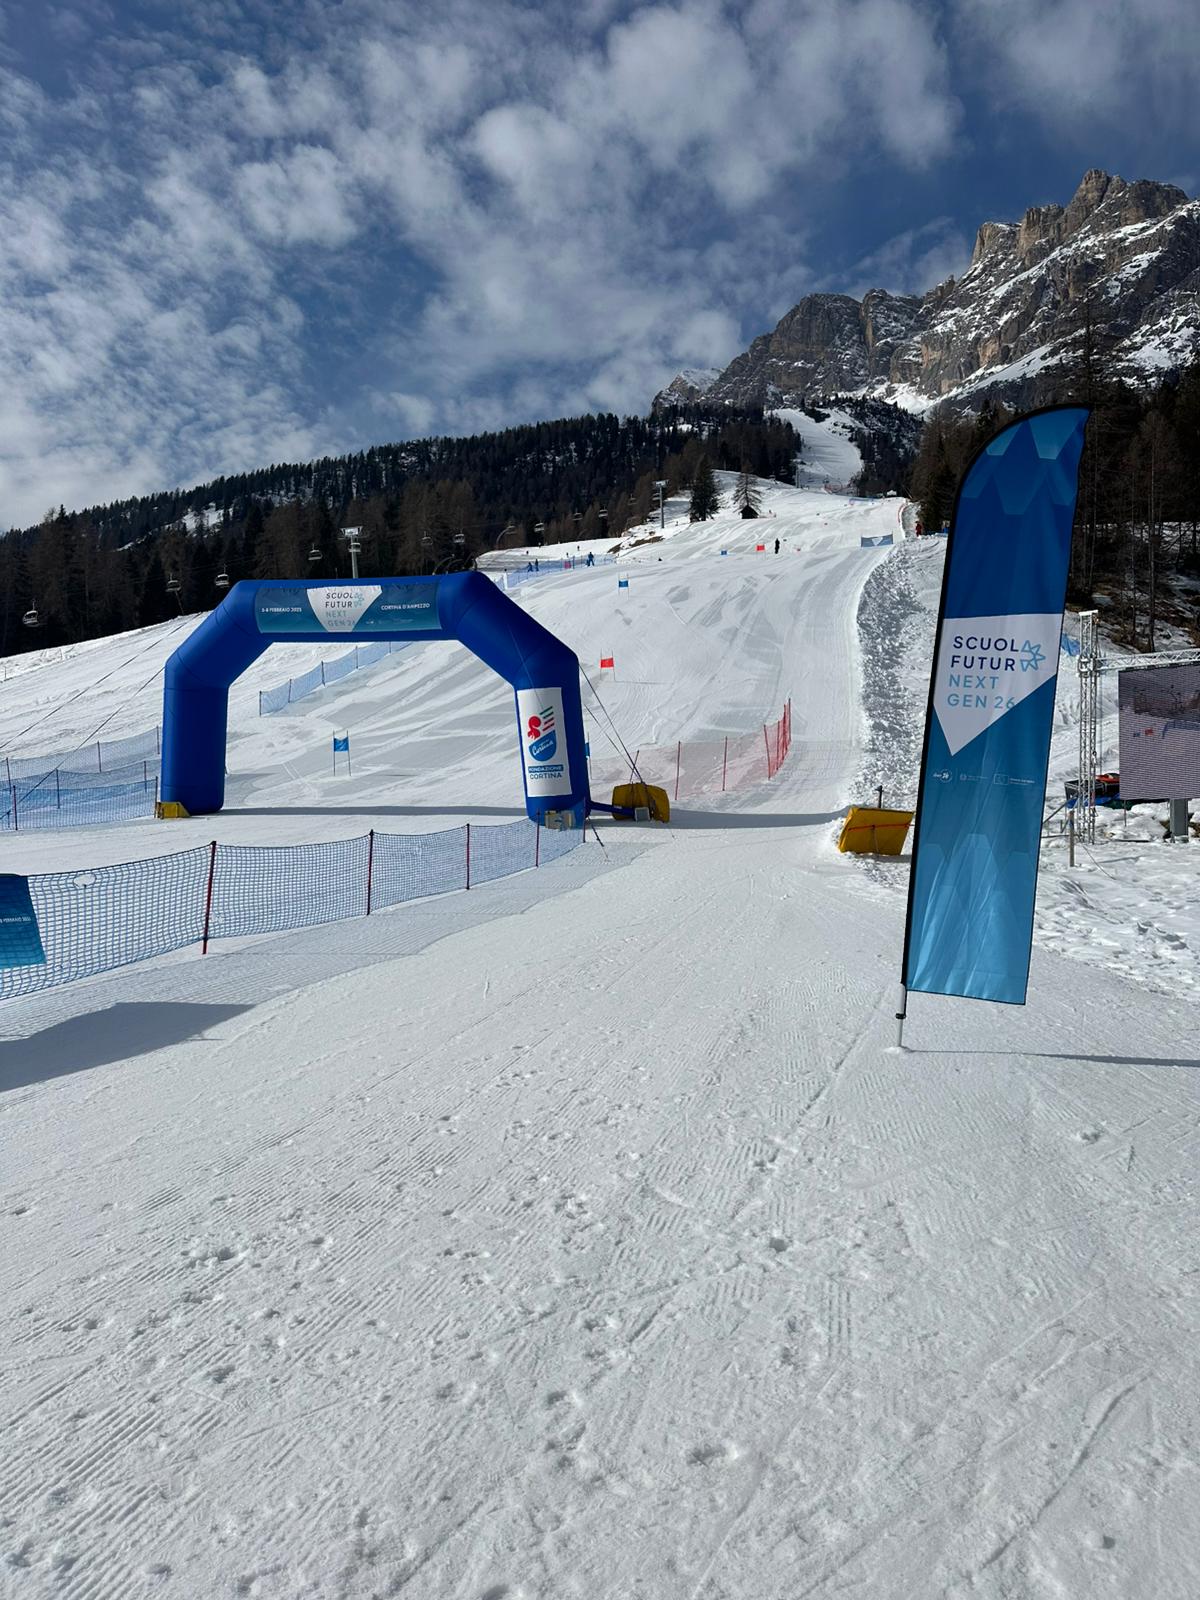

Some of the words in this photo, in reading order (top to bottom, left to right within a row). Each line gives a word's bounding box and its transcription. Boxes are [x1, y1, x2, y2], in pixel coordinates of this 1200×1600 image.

[326, 592, 353, 600] SCUOL
[325, 610, 346, 618] NEXT
[953, 636, 1019, 652] SCUOL
[950, 655, 1016, 671] FUTUR
[948, 674, 999, 690] NEXT
[947, 693, 988, 709] GEN
[994, 695, 1016, 709] 26
